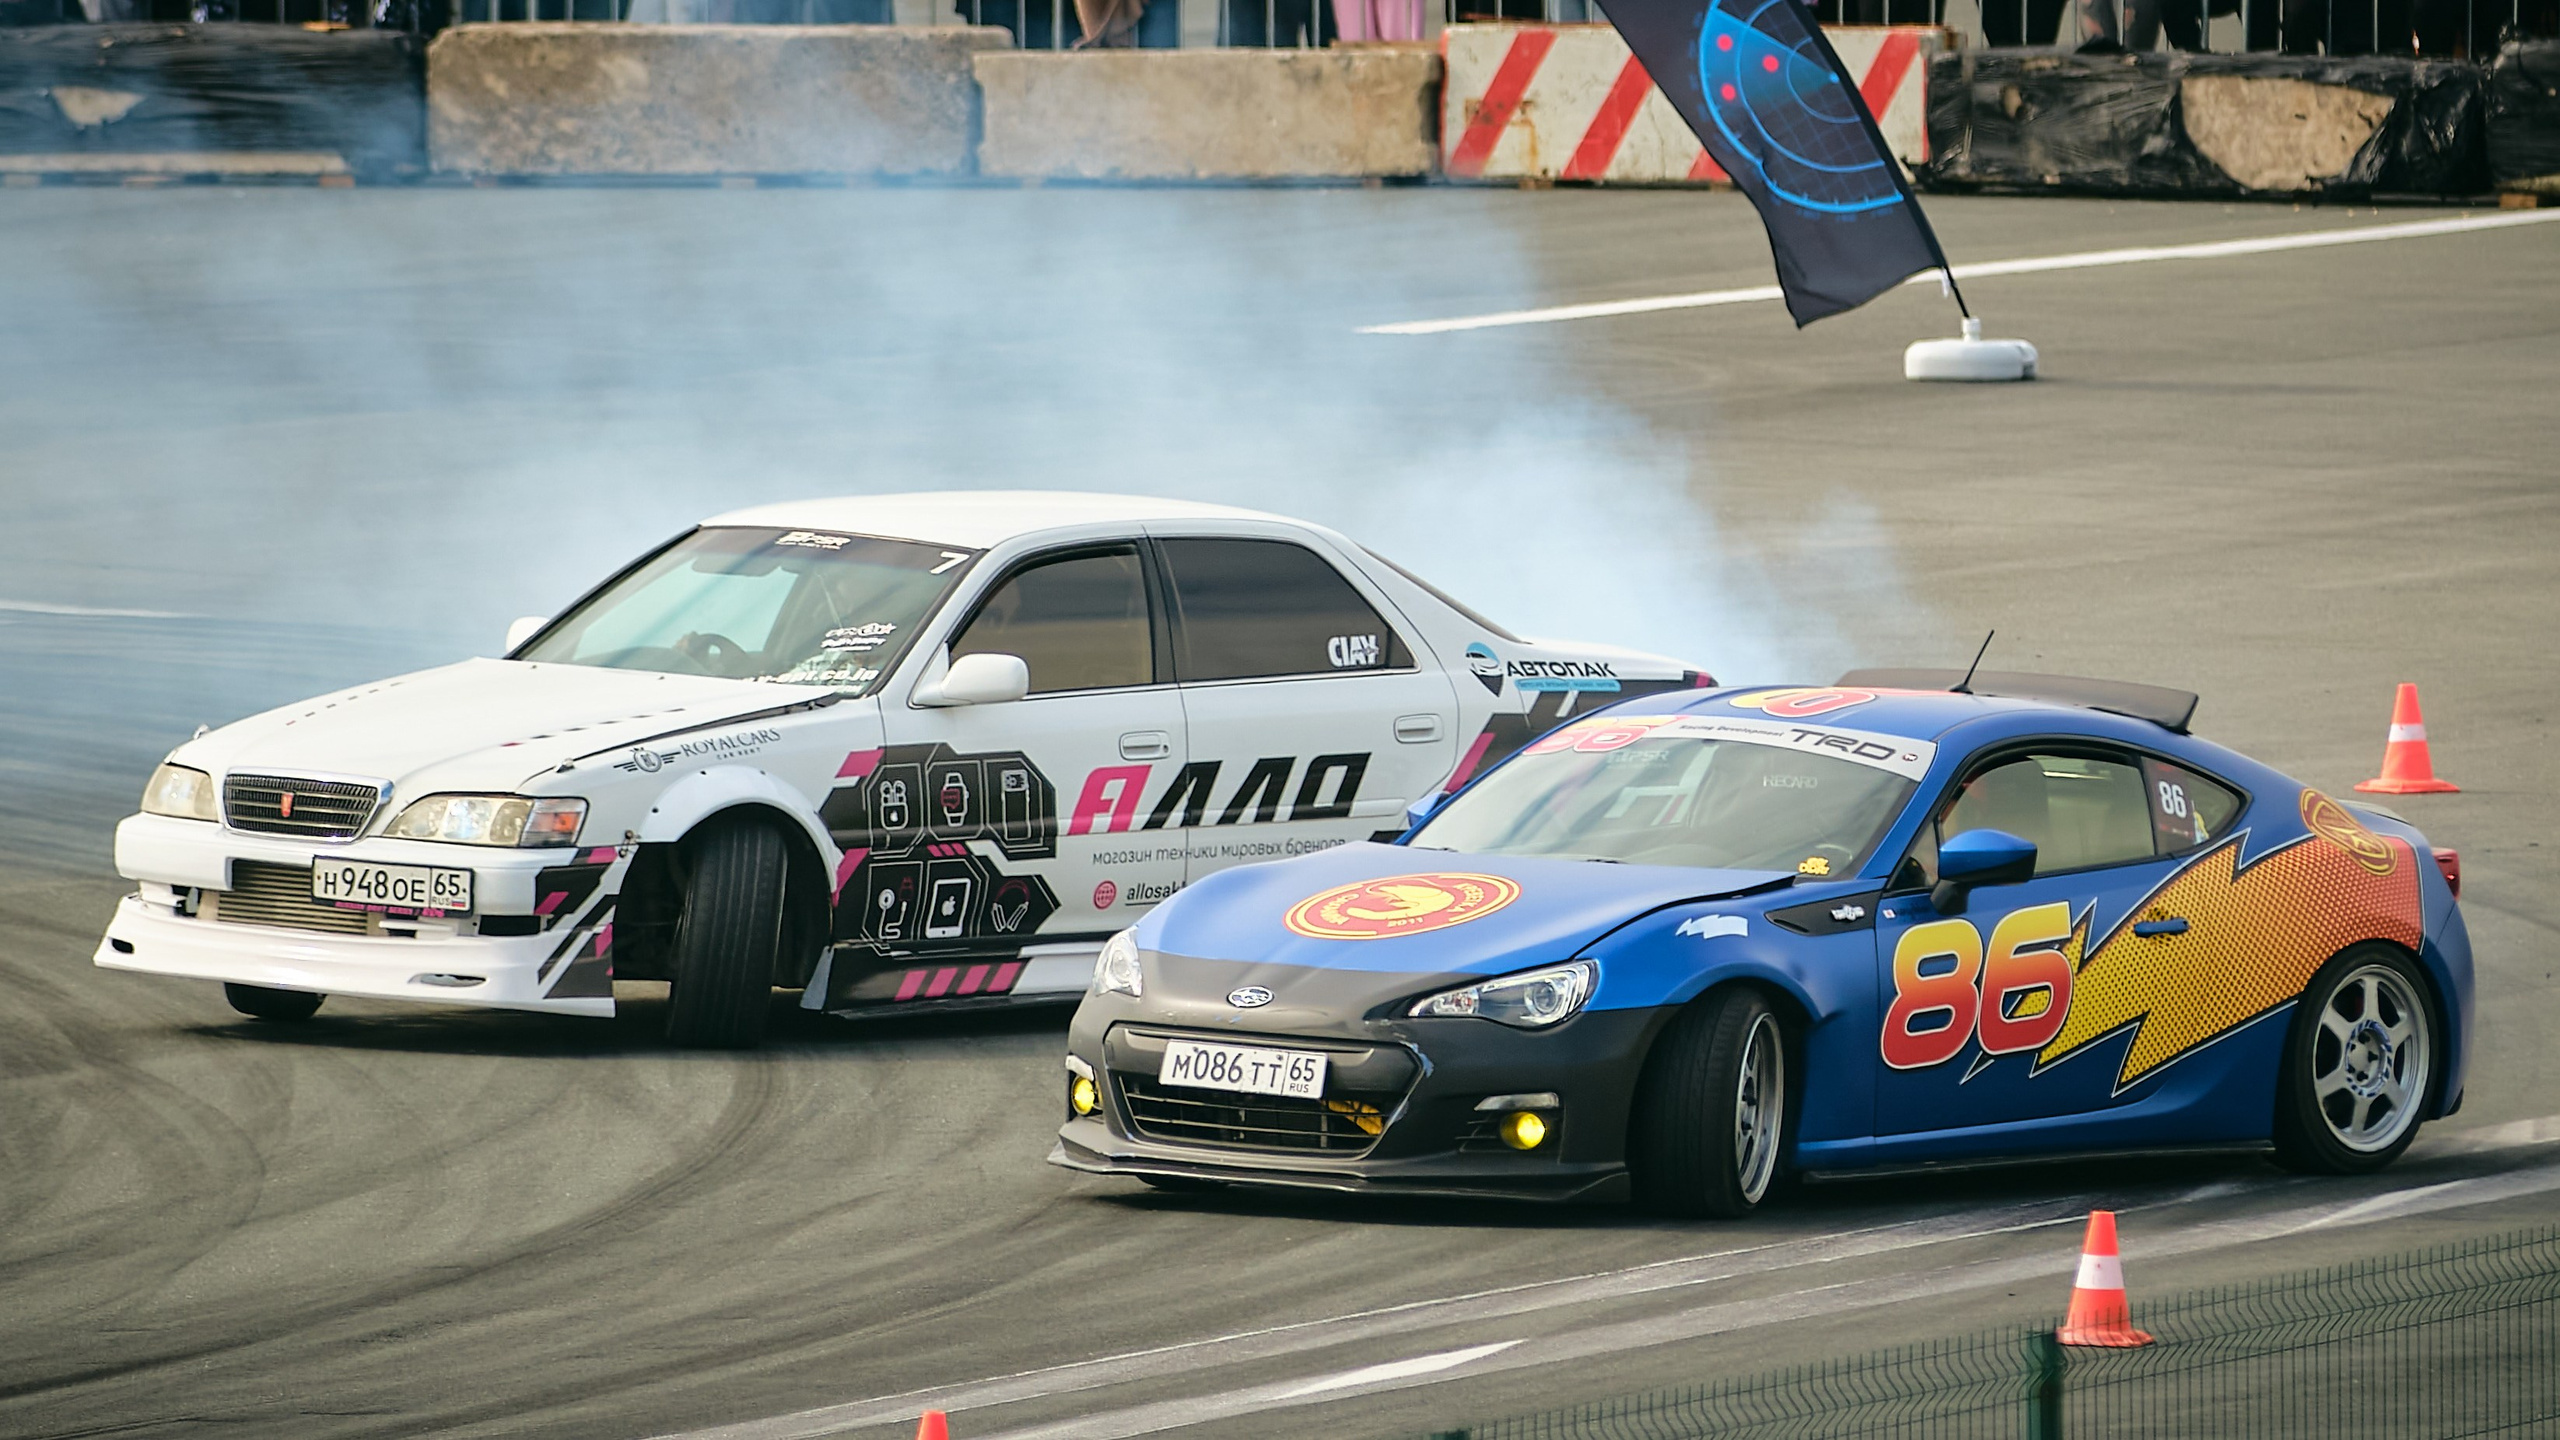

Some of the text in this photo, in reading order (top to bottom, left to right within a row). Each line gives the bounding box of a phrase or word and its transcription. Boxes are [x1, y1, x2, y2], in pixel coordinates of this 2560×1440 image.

[930, 551, 970, 574] 7
[1506, 660, 1618, 678] АВТОПАК
[1717, 725, 1785, 738] Development
[1790, 728, 1897, 762] TRD
[1066, 752, 1372, 837] АЛЛО
[2158, 780, 2188, 819] 86
[1092, 850, 1152, 866] магазин
[1156, 845, 1218, 861] техники
[1221, 842, 1283, 860] мировых
[433, 872, 461, 896] 65
[431, 896, 451, 907] RUS
[1880, 900, 2074, 1070] 86
[1289, 1056, 1317, 1083] 65
[1288, 1081, 1310, 1094] RUS
